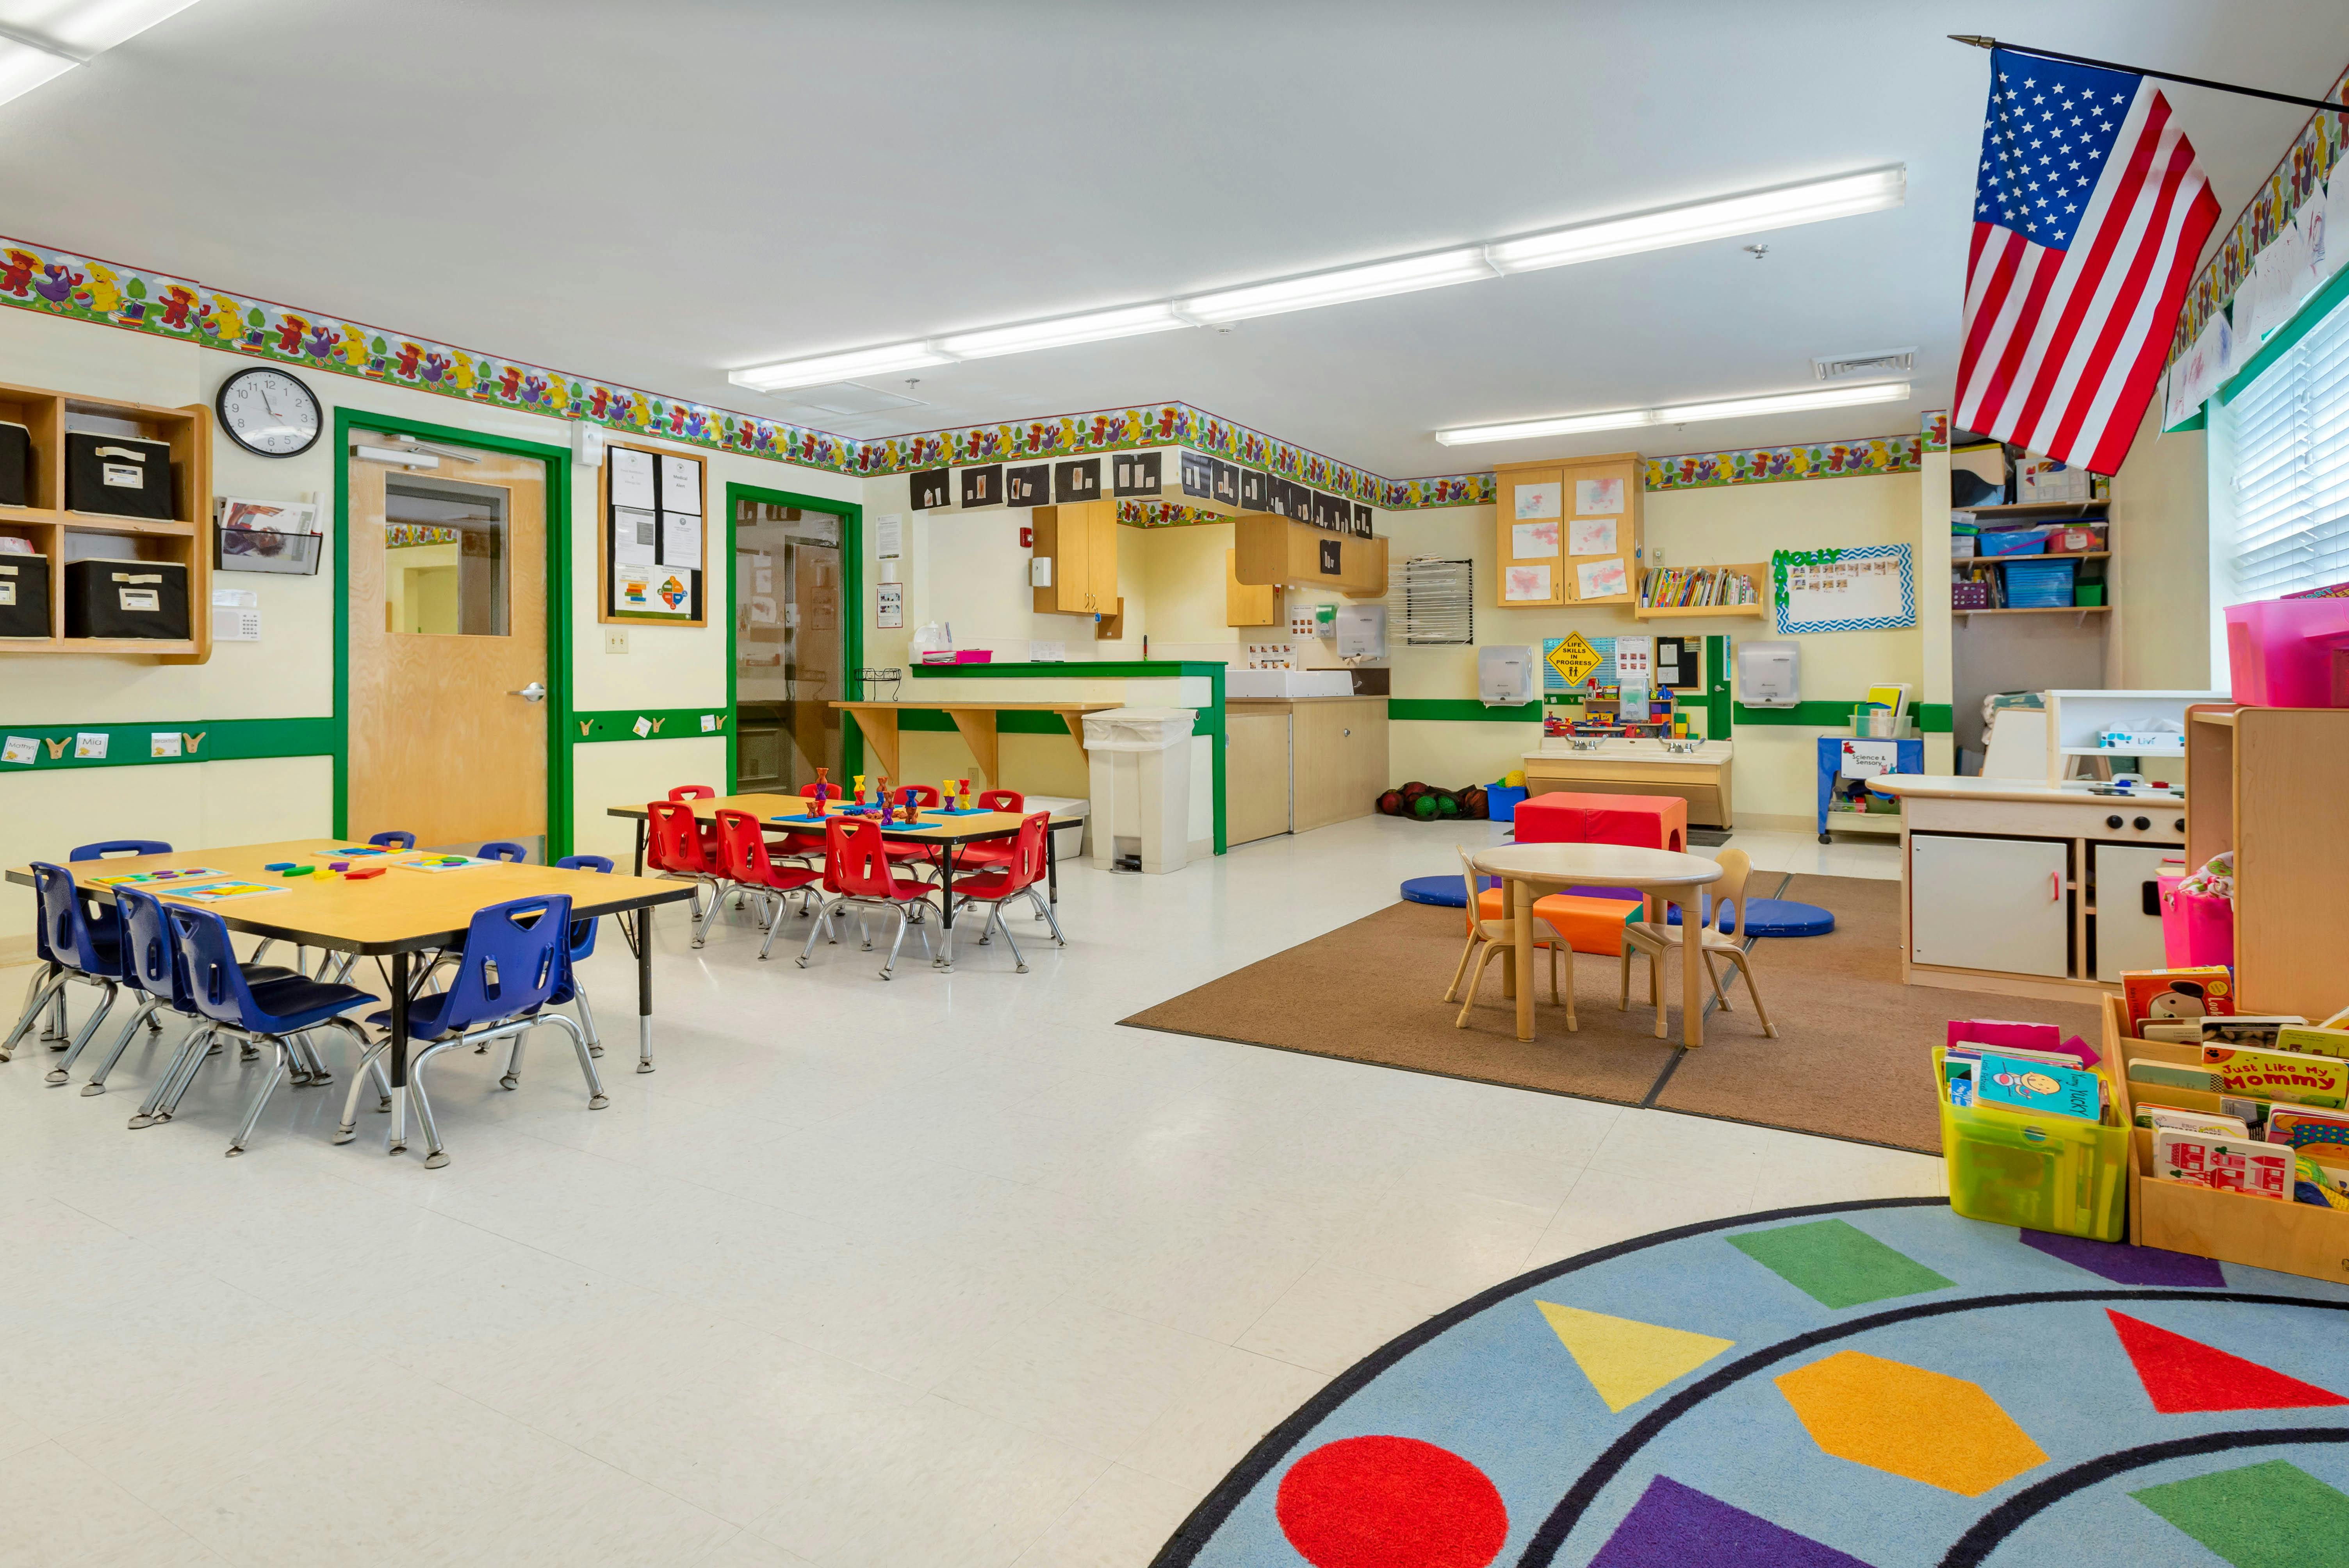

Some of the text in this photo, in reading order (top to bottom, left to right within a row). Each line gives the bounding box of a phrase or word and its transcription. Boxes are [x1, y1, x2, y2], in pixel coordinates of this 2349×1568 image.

[248, 382, 257, 392] 11
[264, 380, 276, 390] 12
[236, 389, 248, 399] 10
[284, 388, 288, 396] 1
[232, 403, 239, 412] 9
[296, 398, 302, 408] 2
[301, 413, 308, 422] 3
[238, 419, 244, 428] 8
[268, 437, 275, 446] 6
[284, 436, 291, 444] 5
[1772, 548, 1841, 567] MOLLY
[2222, 1063, 2328, 1076] Just Like My
[2223, 1074, 2336, 1090] Mommy
[2066, 1073, 2089, 1117] Yummy YUCKY
